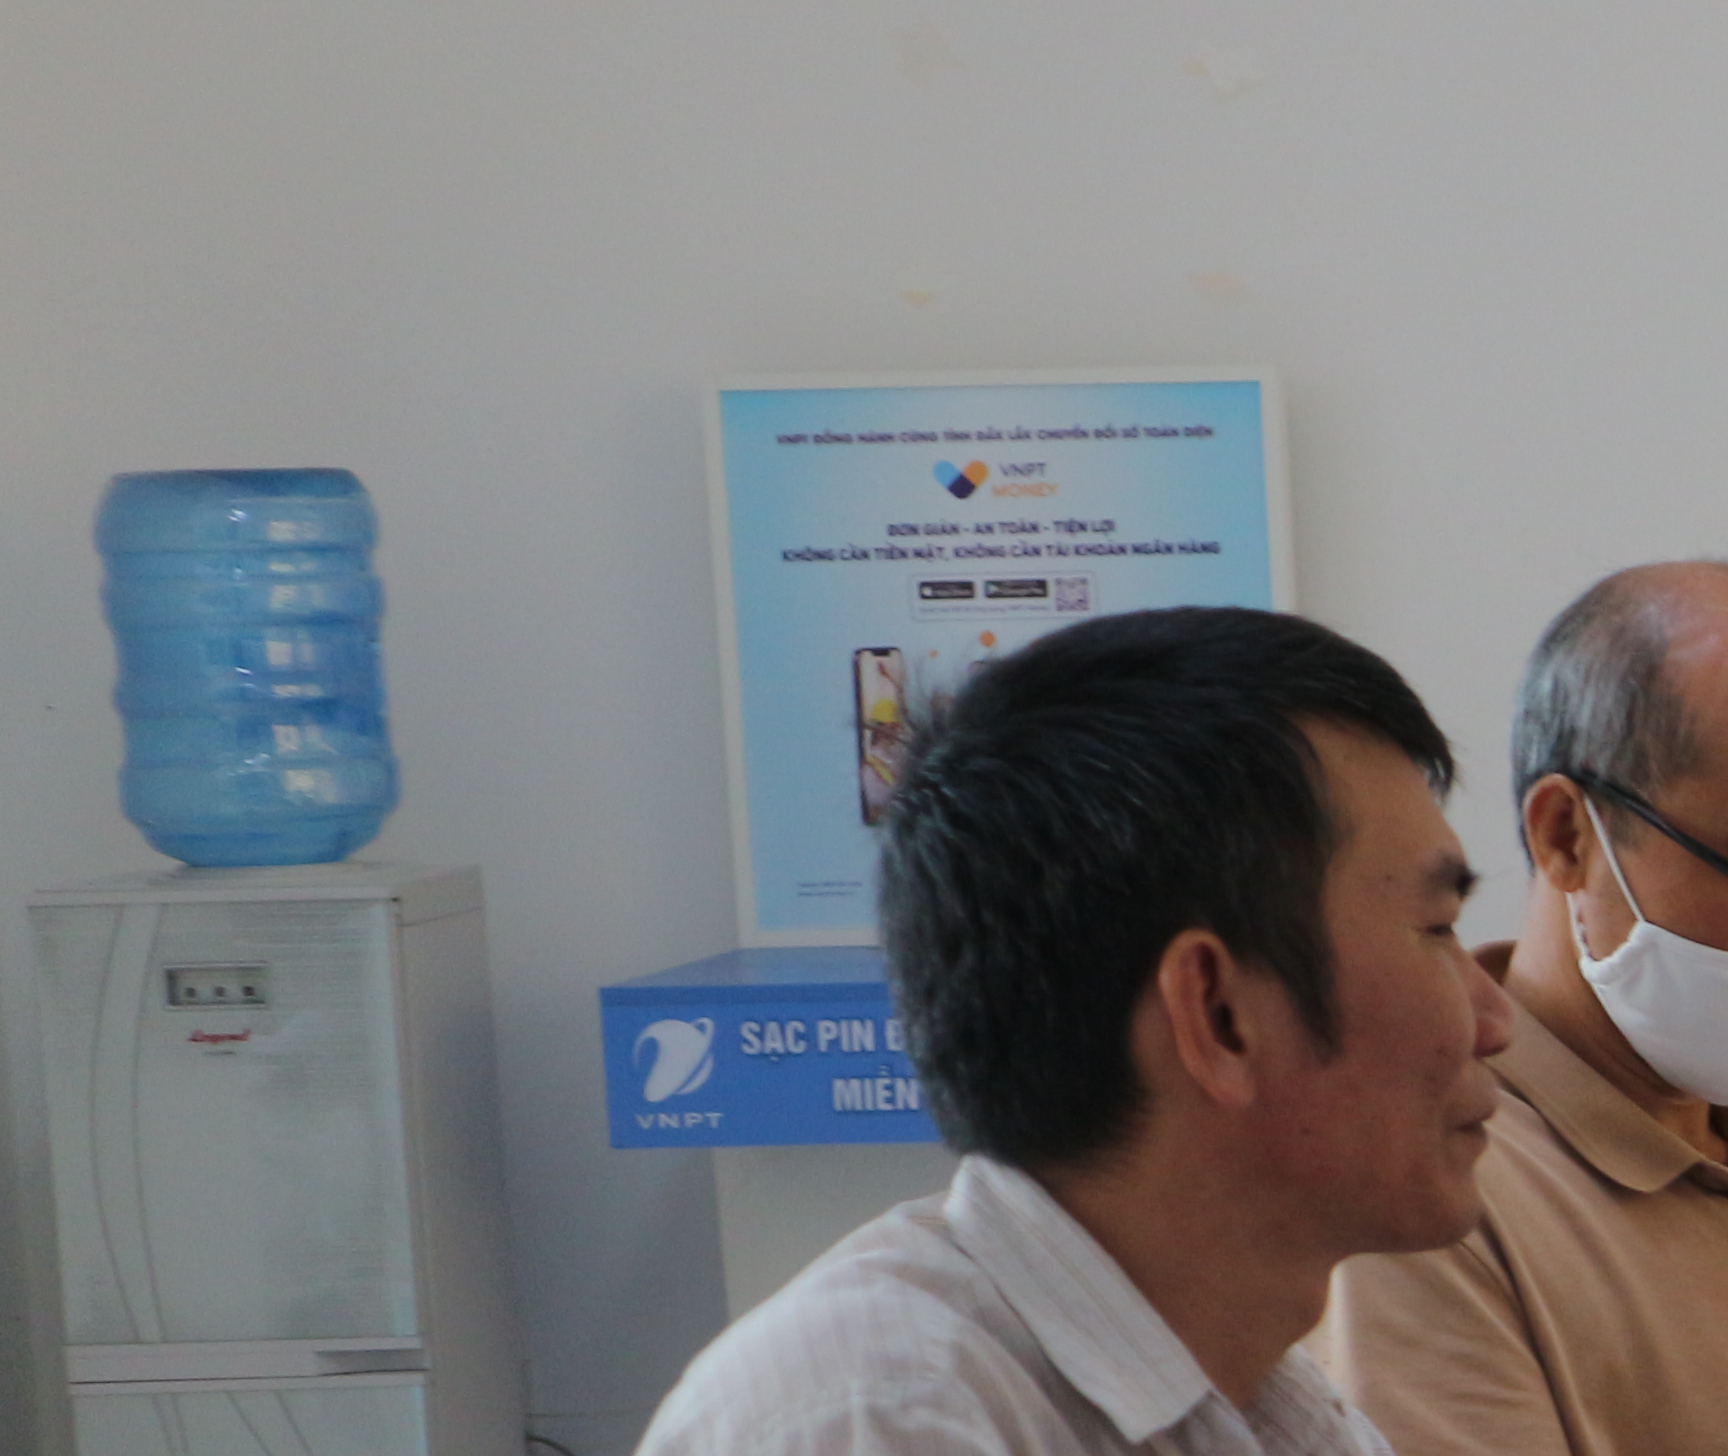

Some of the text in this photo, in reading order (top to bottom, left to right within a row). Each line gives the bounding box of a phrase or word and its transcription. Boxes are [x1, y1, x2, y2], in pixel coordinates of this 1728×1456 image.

[1000, 462, 1046, 477] VNPT
[992, 482, 1058, 497] MONEY
[974, 522, 994, 534] AN
[740, 1020, 808, 1063] SẠC
[816, 1019, 876, 1053] PIN
[833, 1064, 921, 1113] MIỀN
[636, 1111, 724, 1129] VNPT
